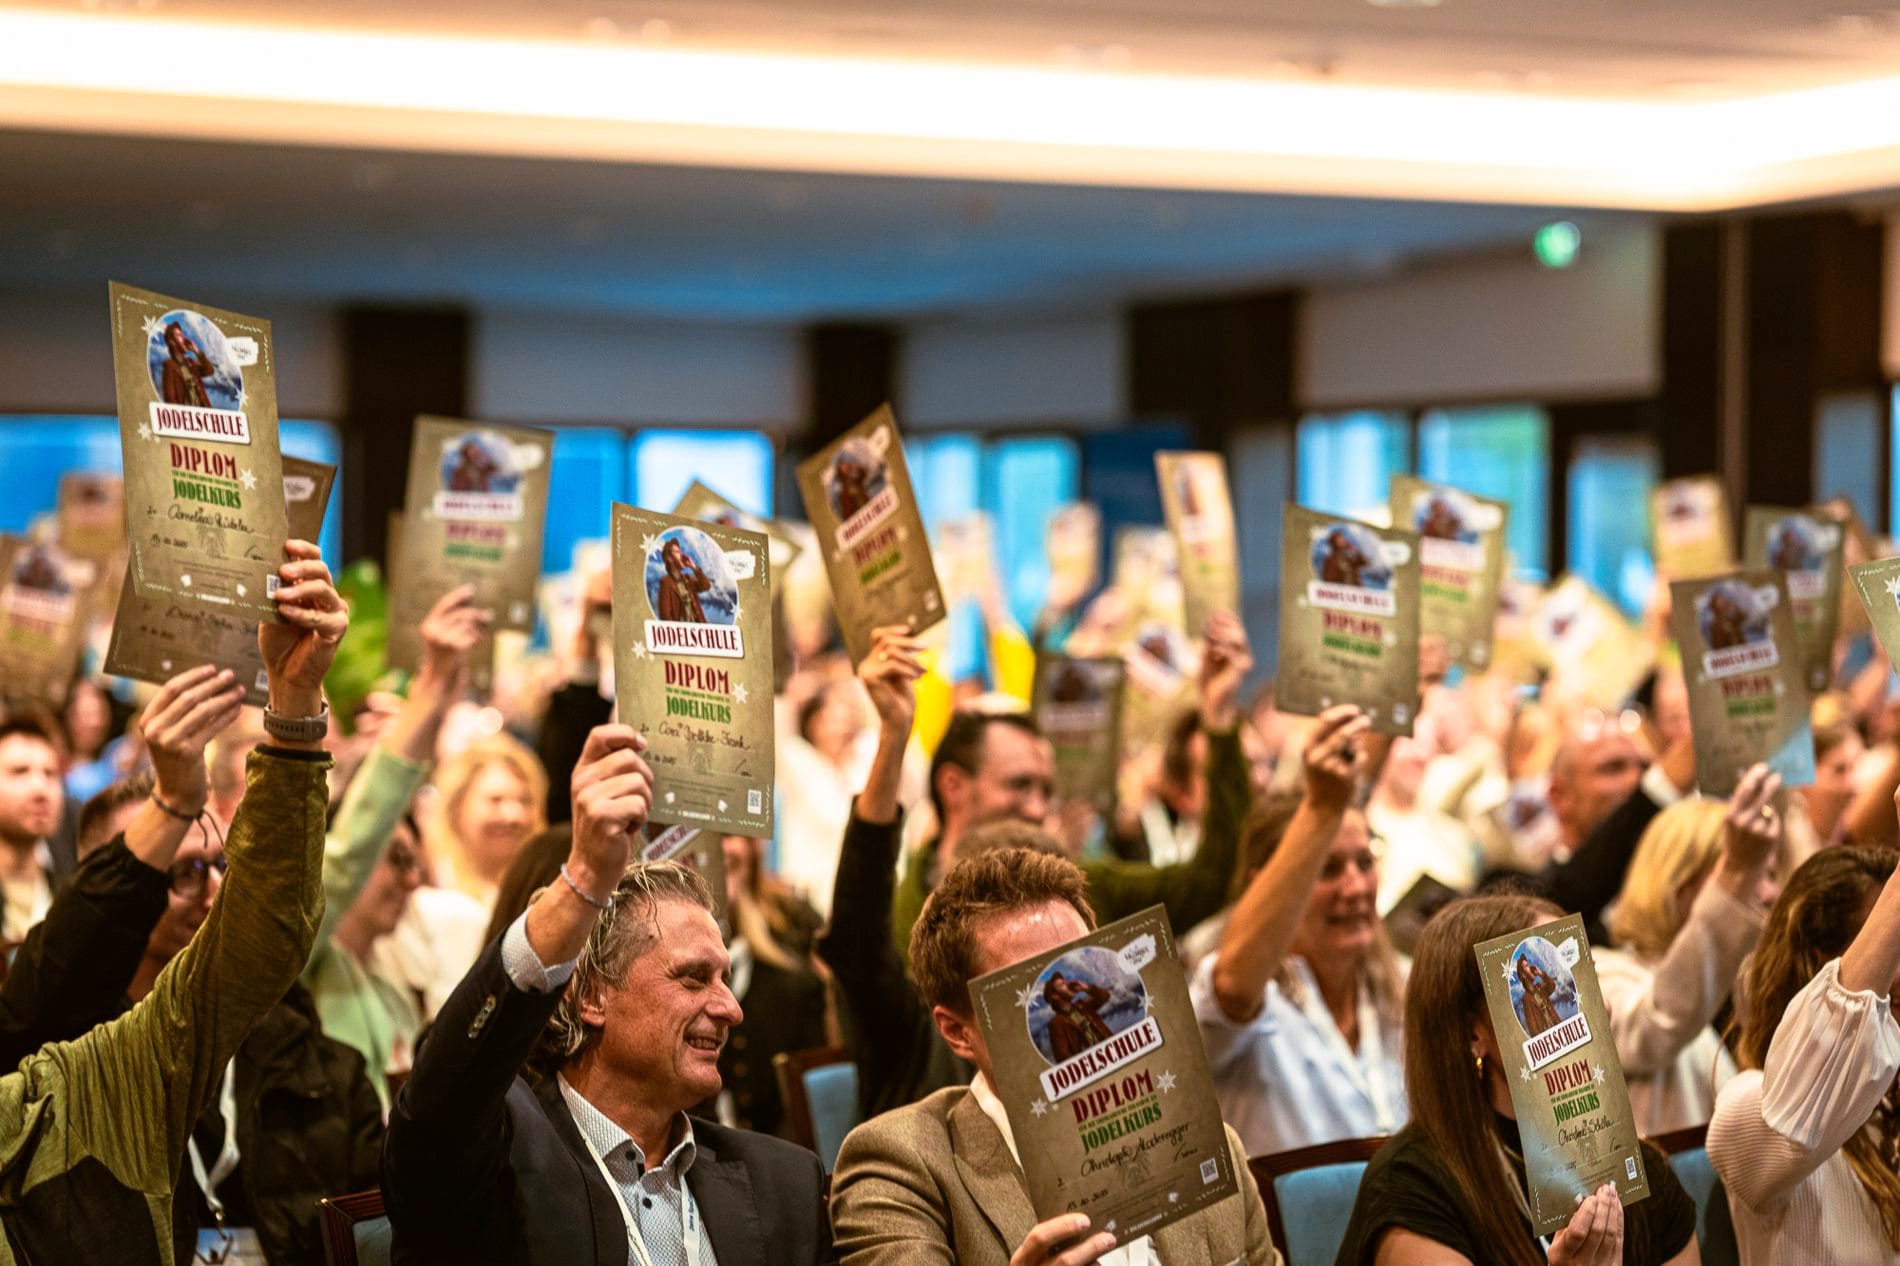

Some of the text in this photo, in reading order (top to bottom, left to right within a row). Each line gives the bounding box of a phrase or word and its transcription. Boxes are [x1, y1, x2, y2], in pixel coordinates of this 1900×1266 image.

[156, 407, 244, 437] JODELSCHULE
[170, 442, 237, 480] DIPLOM
[173, 479, 242, 510] JODELKURS
[652, 625, 738, 651] JODELSCHULE
[664, 660, 730, 695] DIPLOM
[666, 695, 732, 724] JODELKURS
[1048, 1021, 1156, 1098] JODELSCHULE
[1527, 1016, 1588, 1068] JODELSCHULE
[1071, 1067, 1154, 1124] DIPLOM
[1544, 1058, 1592, 1096] DIPLOM
[1553, 1090, 1601, 1127] JODELKURS
[1080, 1101, 1162, 1156] JODELKURS
